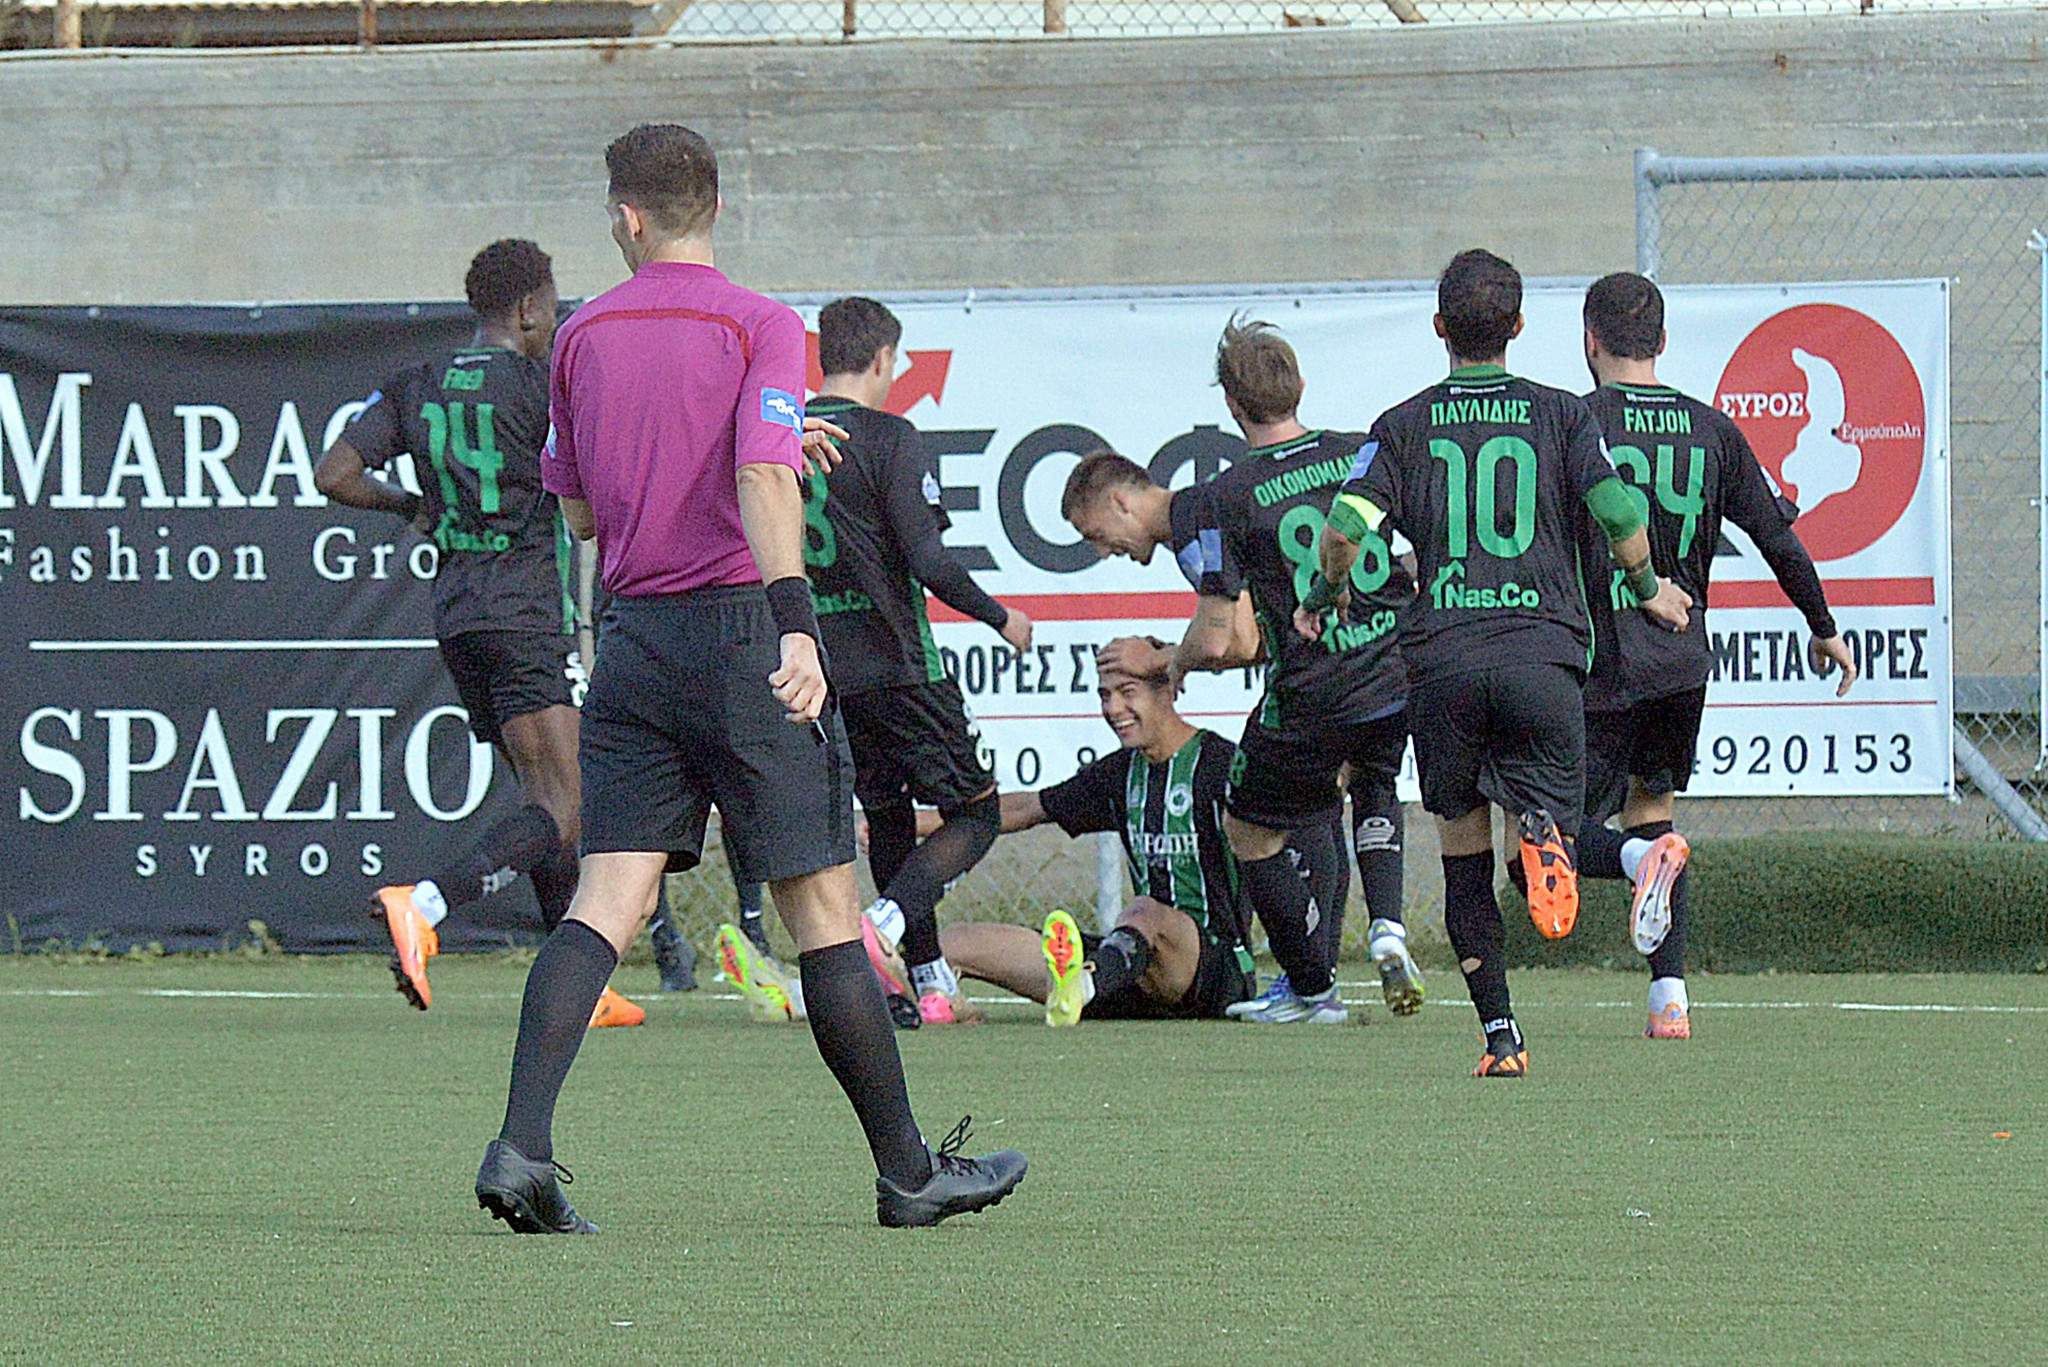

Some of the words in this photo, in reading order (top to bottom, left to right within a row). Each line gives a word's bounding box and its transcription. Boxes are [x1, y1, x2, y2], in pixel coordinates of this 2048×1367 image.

[1431, 399, 1531, 426] ΠΑΥΛΙΔΗΣ
[1623, 407, 1692, 434] FATJON
[1720, 392, 1804, 419] ΣΥΡΟΣ
[1842, 421, 1922, 444] Ερμούπολη
[420, 402, 503, 514] 14
[1429, 436, 1537, 558] 10
[312, 526, 439, 581] Gro
[1445, 582, 1540, 608] Nas.Co
[19, 706, 494, 822] SPAZIO
[136, 843, 384, 876] SYROS
